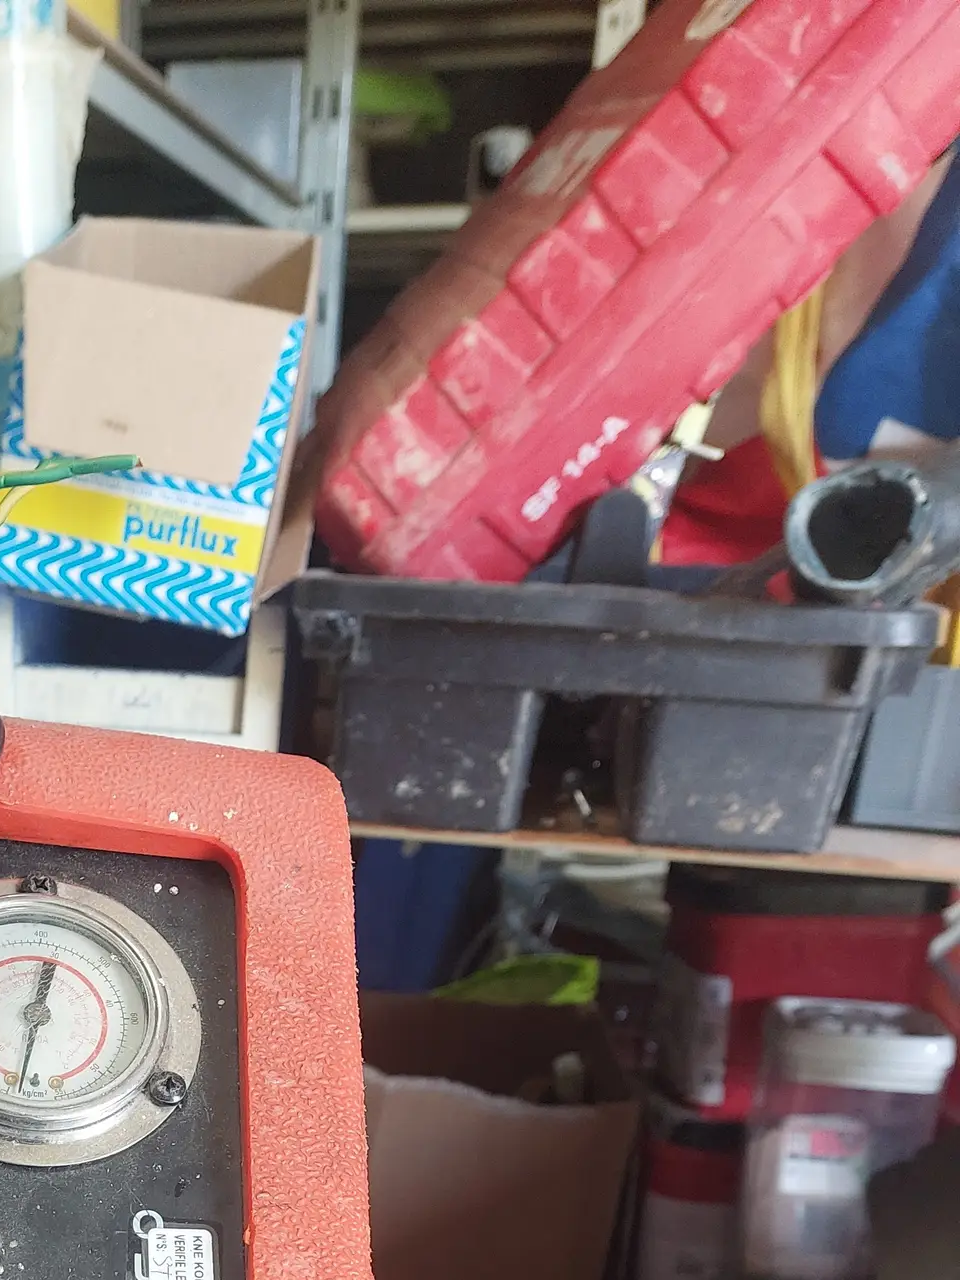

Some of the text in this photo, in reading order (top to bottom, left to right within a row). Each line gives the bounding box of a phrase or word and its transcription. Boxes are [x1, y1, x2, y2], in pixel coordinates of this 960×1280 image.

[123, 513, 239, 557] purflux
[34, 930, 48, 939] 400
[50, 951, 60, 960] 30
[98, 956, 111, 969] 500
[130, 1012, 140, 1026] 600
[89, 1063, 100, 1073] 50
[174, 1234, 186, 1268] VERIFIE
[193, 1235, 204, 1259] KNE
